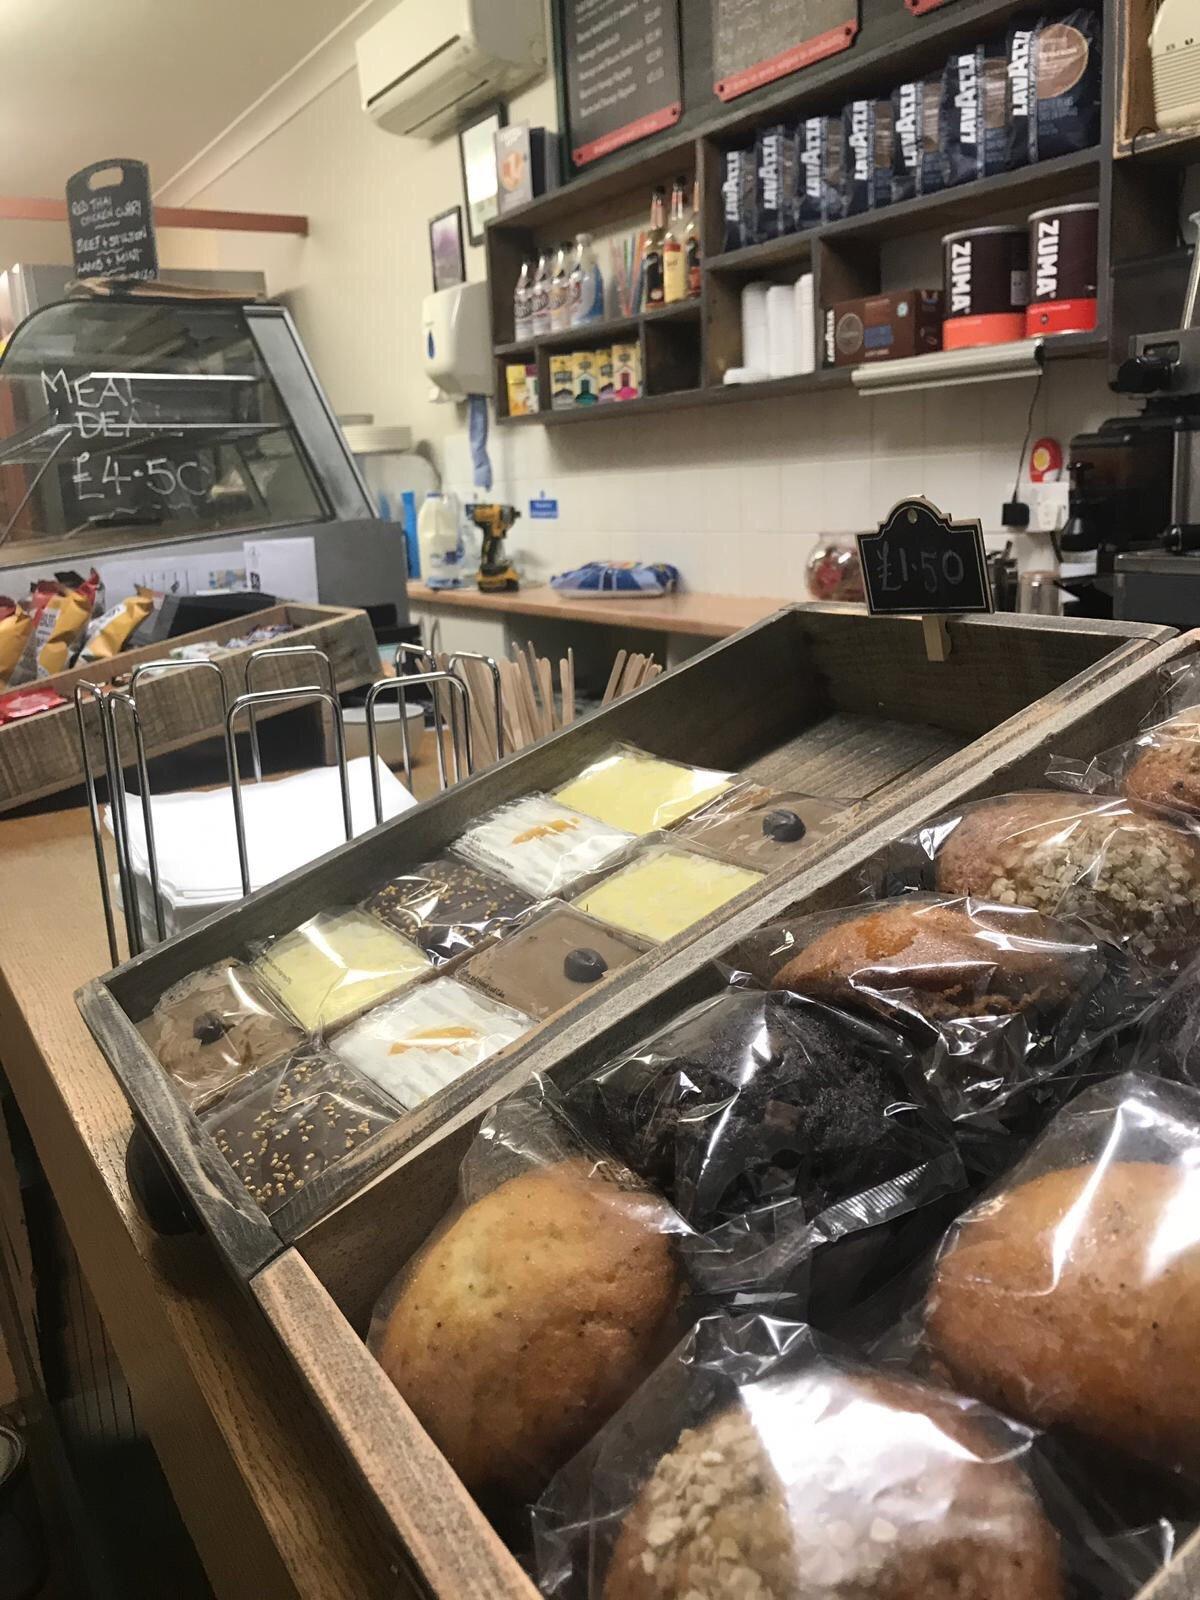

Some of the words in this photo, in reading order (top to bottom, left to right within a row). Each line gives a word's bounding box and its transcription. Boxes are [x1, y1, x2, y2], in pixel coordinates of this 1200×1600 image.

[896, 83, 916, 167] LAVAZZA
[954, 54, 977, 143] LAVAZZA
[758, 135, 777, 210] LAVAZZA
[801, 117, 820, 197] LAVAZZA
[848, 100, 868, 181] LAVAZZA
[722, 151, 739, 221] LAVAZZA
[951, 241, 971, 314] ZUMA
[1036, 219, 1060, 298] ZUMA
